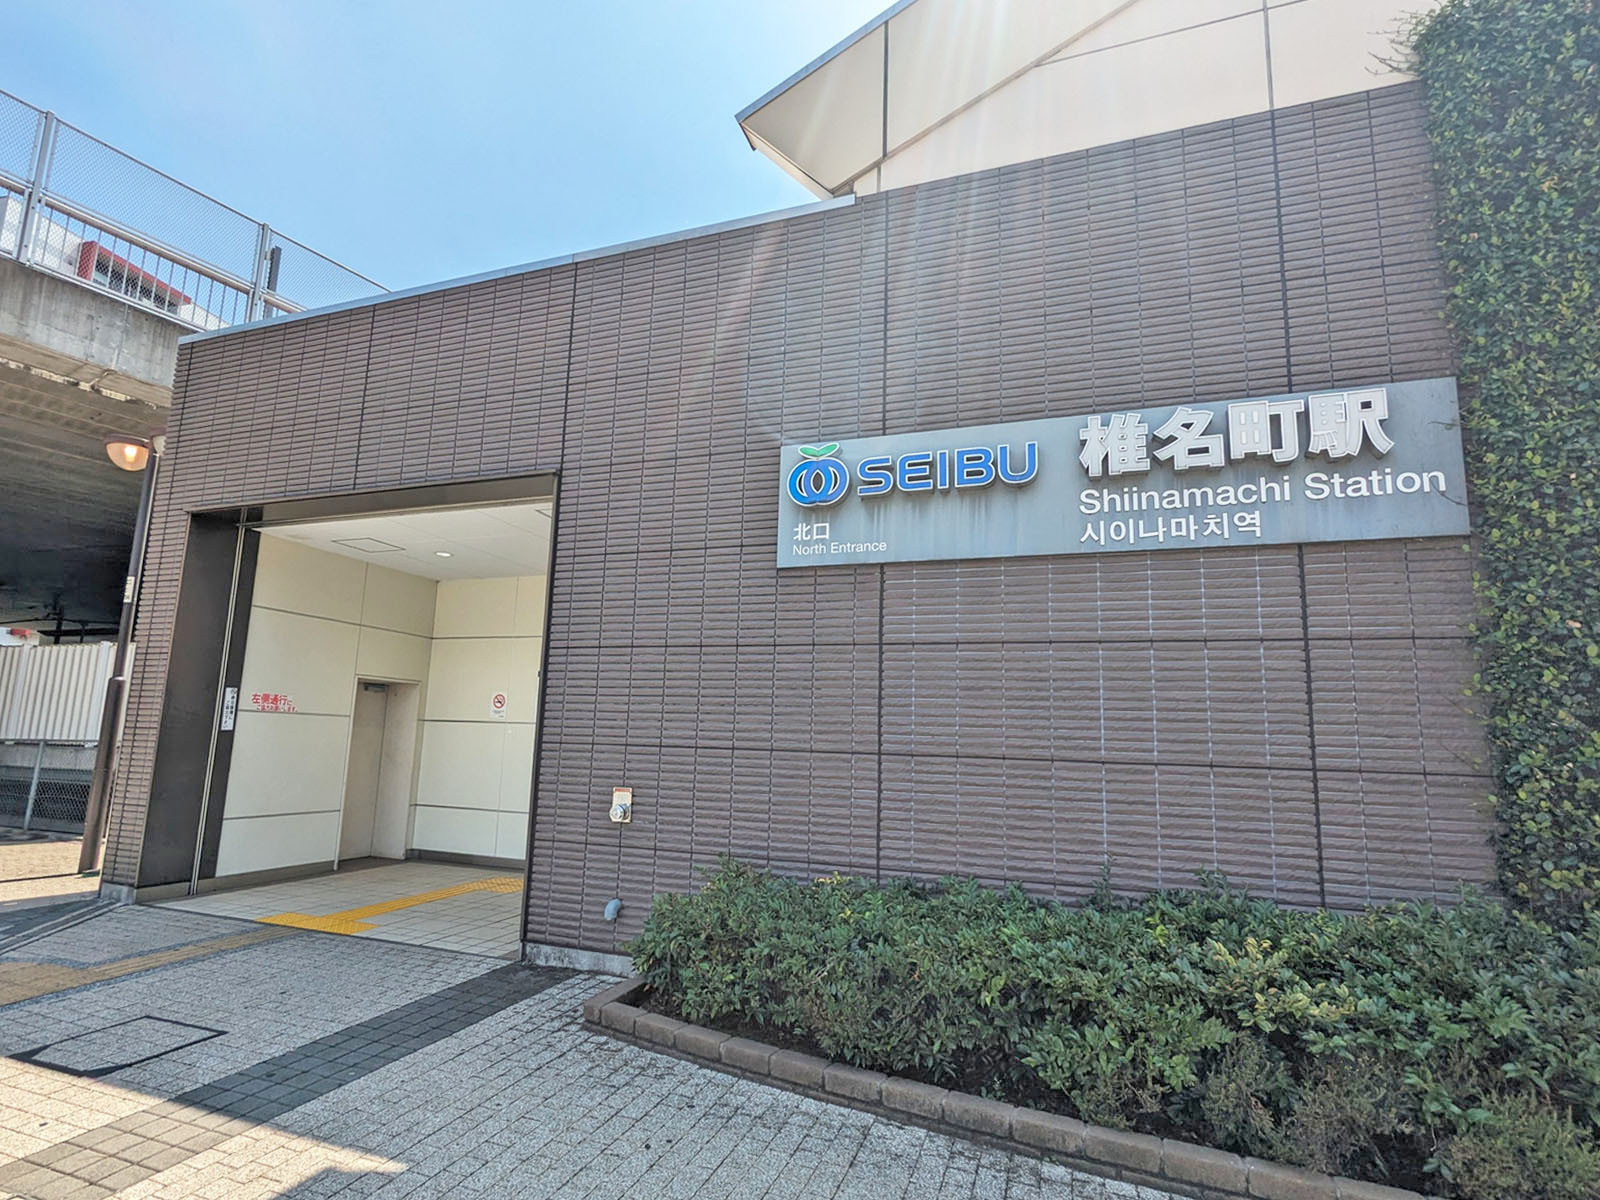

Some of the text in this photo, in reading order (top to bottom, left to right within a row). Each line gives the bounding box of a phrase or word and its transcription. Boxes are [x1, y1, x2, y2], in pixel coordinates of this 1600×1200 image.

[1079, 387, 1395, 477] 椎名町駅
[857, 441, 1038, 497] SEIBU
[1079, 467, 1447, 515] Shiinamachi Station
[792, 541, 887, 556] North Entrance
[793, 522, 830, 541] 北口
[1079, 510, 1262, 546] 시이나마치역
